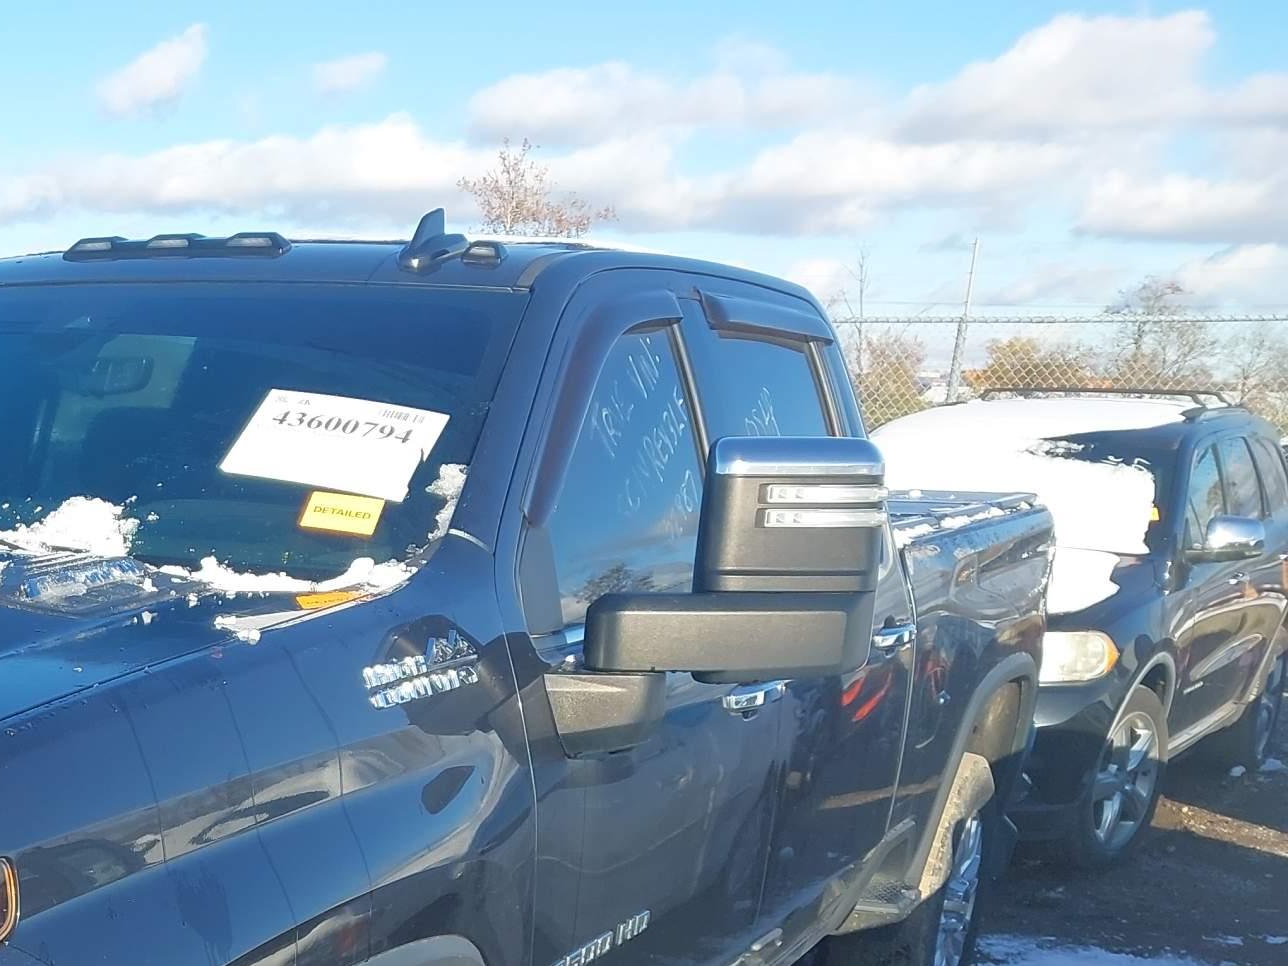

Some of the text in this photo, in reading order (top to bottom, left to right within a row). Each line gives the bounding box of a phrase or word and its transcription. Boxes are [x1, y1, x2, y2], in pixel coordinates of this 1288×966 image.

[272, 410, 414, 444] 43600794
[312, 504, 372, 521] DETAILED
[615, 910, 650, 946] HD
